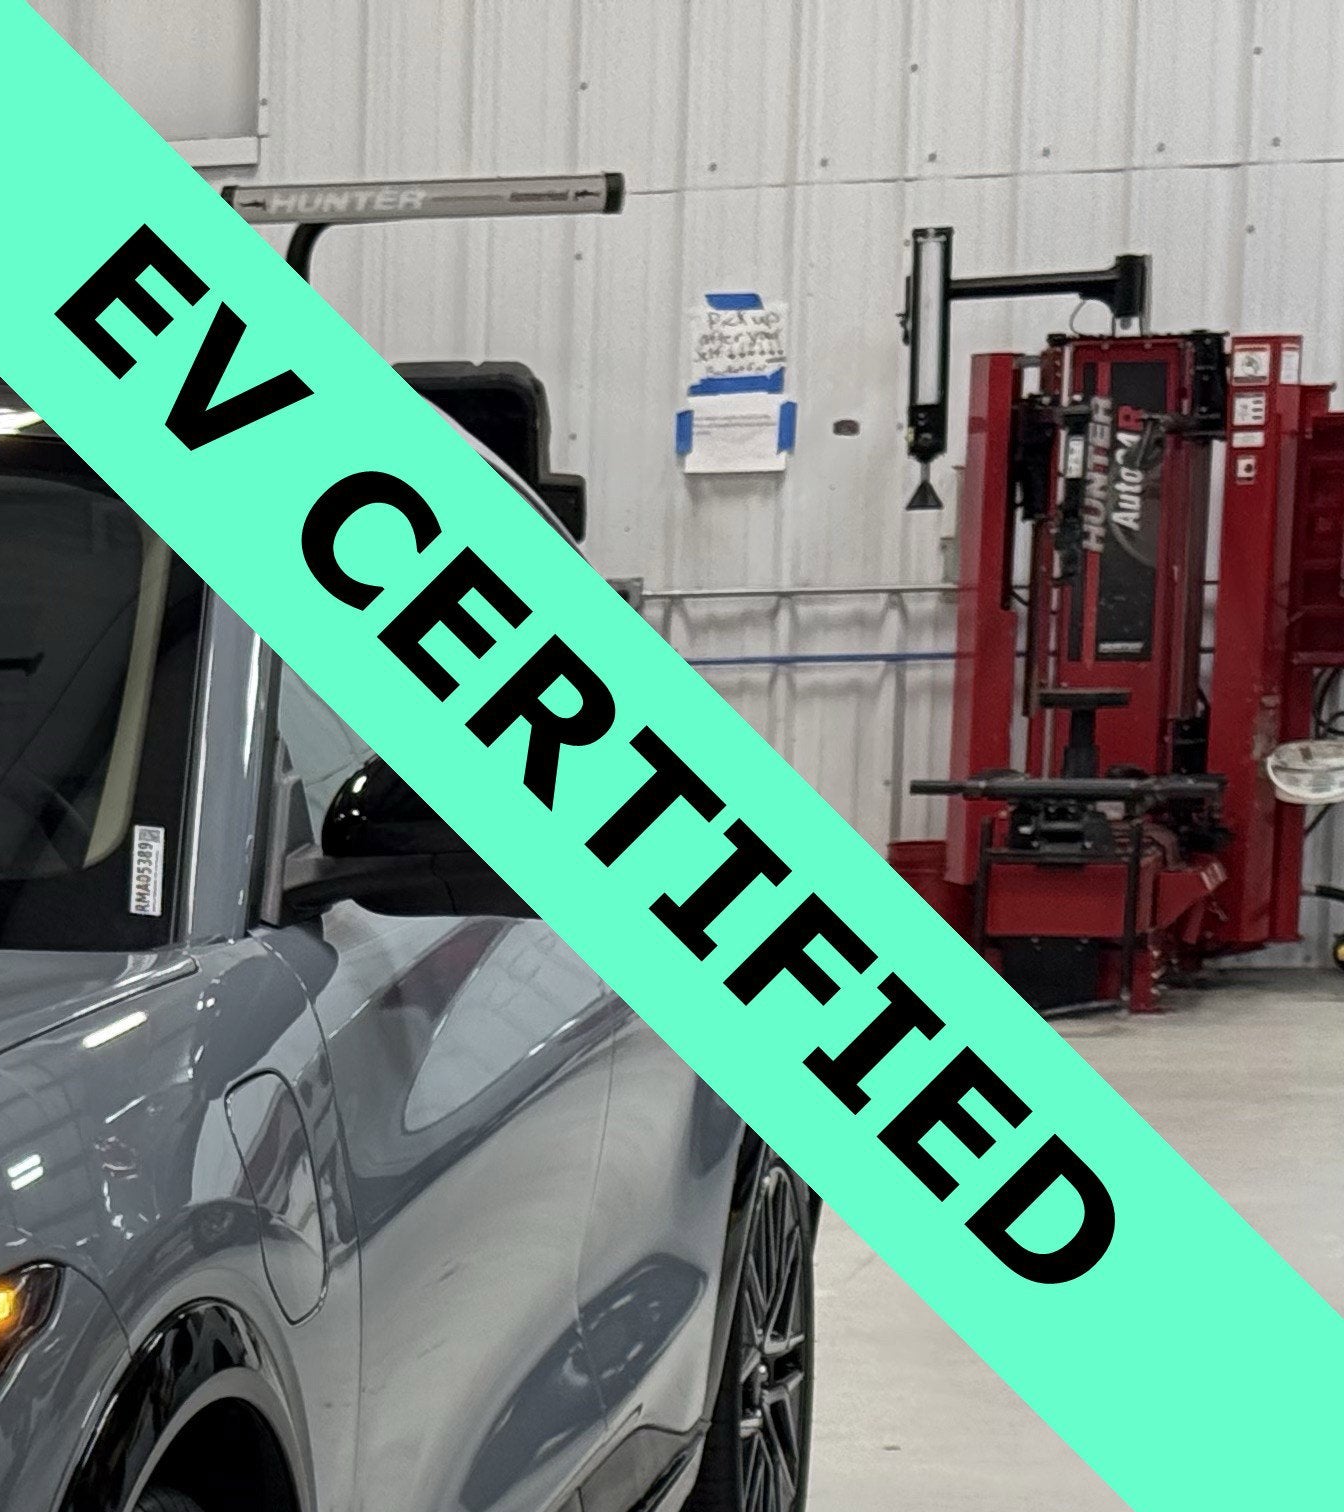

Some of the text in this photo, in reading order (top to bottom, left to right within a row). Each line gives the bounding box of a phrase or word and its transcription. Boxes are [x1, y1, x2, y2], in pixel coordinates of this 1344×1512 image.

[269, 187, 427, 213] HUNTER
[1082, 397, 1112, 551] HUNTER
[134, 842, 153, 912] RMA05389
